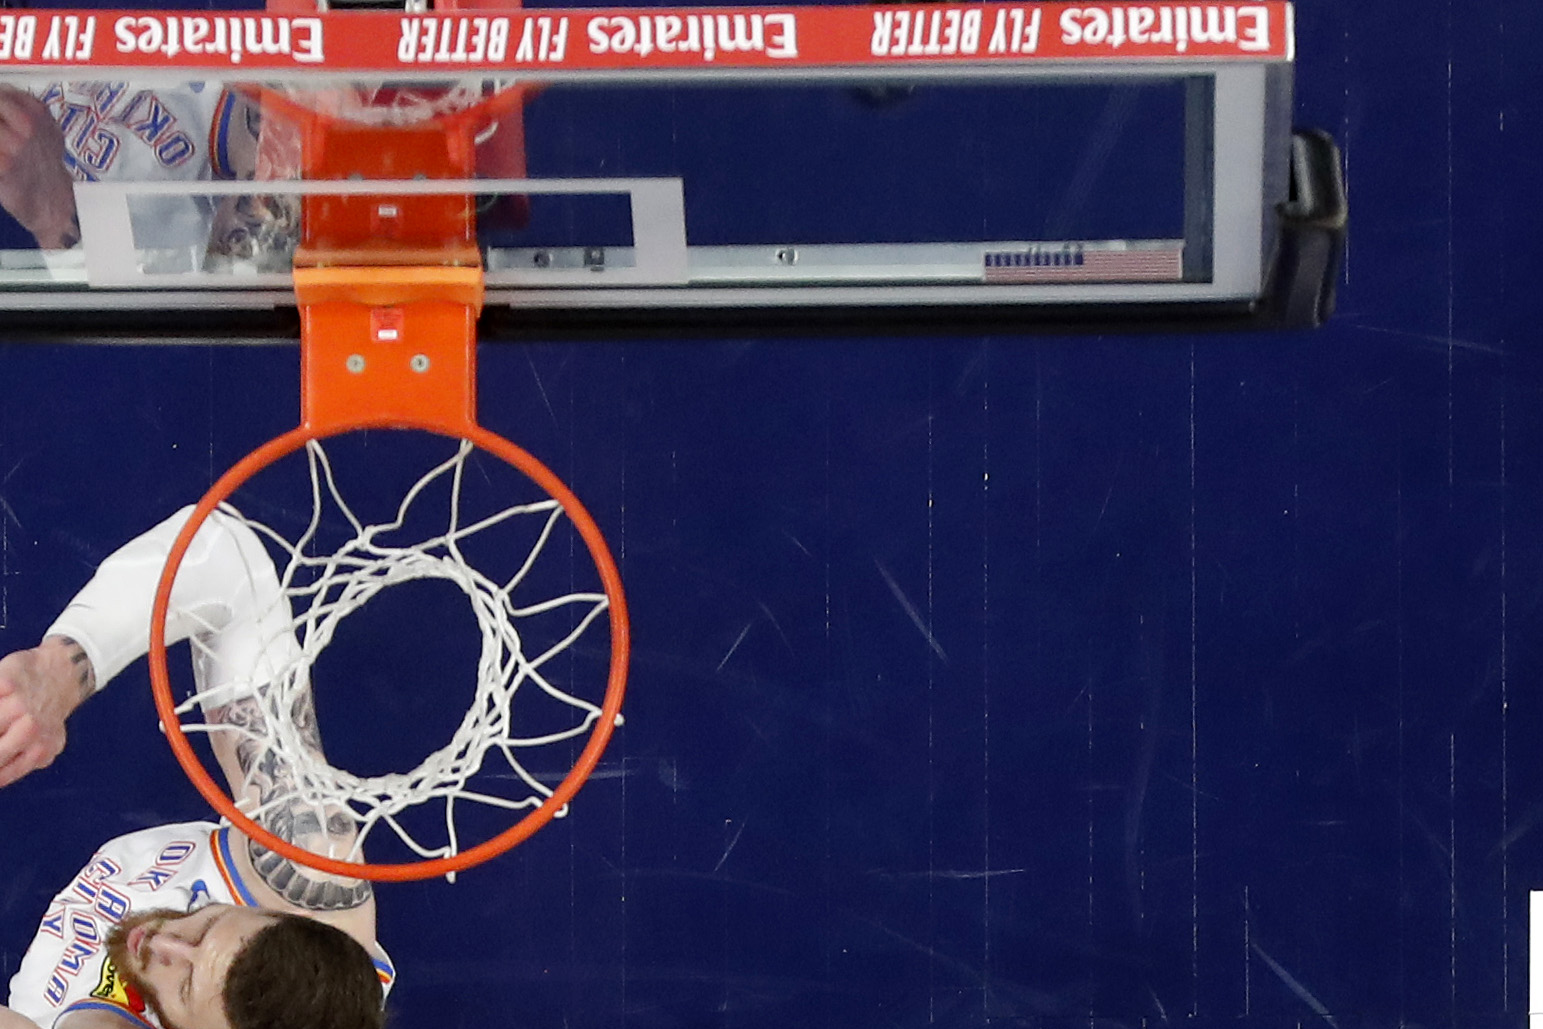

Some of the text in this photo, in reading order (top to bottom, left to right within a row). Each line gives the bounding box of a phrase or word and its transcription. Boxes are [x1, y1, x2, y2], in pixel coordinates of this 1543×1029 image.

[41, 15, 96, 61] FLY
[114, 16, 325, 64] Emirates
[397, 13, 799, 63] Emirates FLY BETTER
[870, 6, 1271, 57] Emirates FLY BETTER
[43, 840, 197, 1008] OKAOMA
